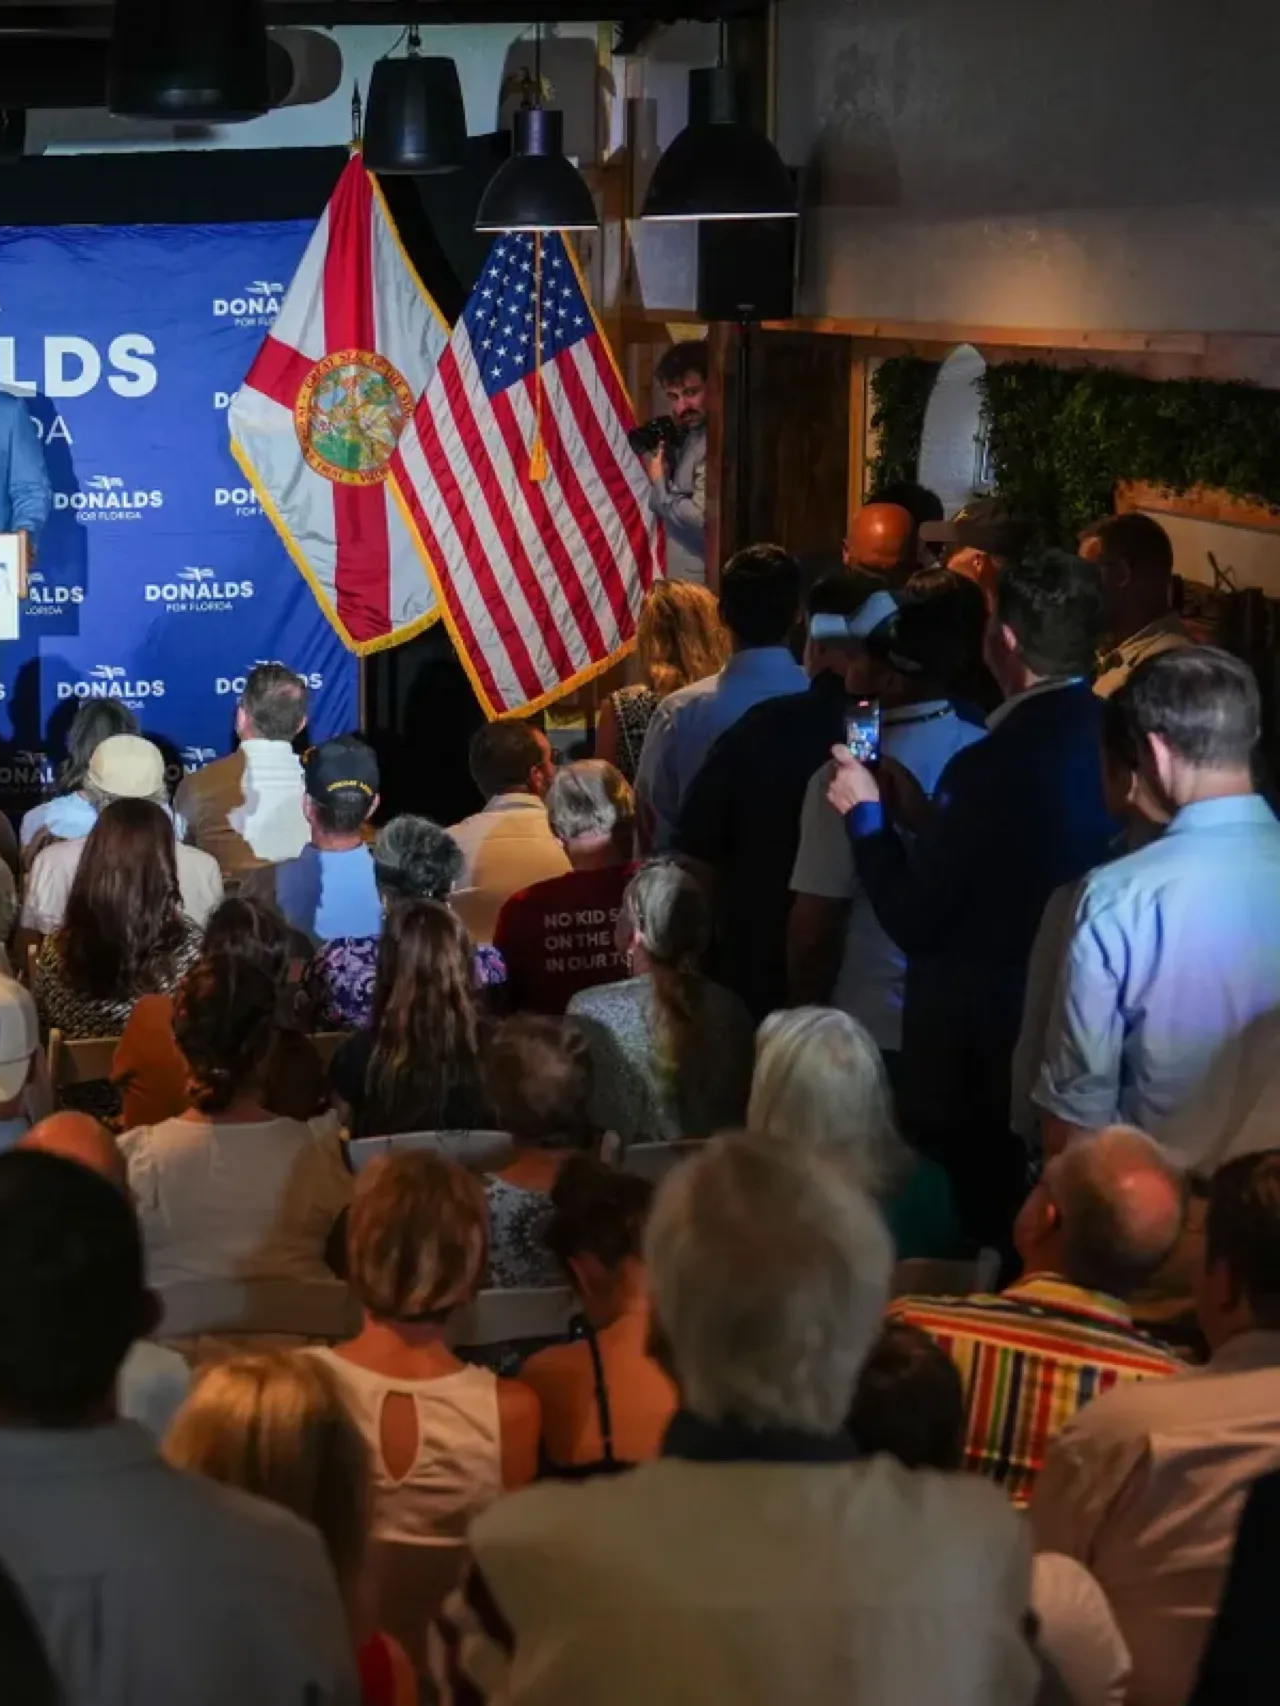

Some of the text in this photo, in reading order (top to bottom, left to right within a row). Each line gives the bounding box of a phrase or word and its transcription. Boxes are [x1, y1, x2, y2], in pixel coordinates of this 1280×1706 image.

[213, 297, 279, 316] DONA
[54, 490, 163, 509] DONALDS
[76, 511, 142, 521] FOR FLORIDA
[145, 580, 254, 601] DONALDS
[166, 601, 233, 612] FOR FLORIDA
[57, 680, 166, 699] DONALDS
[544, 912, 572, 929] NO
[576, 909, 606, 926] KID
[545, 931, 610, 950] ON THE
[546, 958, 564, 973] IN
[567, 953, 607, 971] OUR
